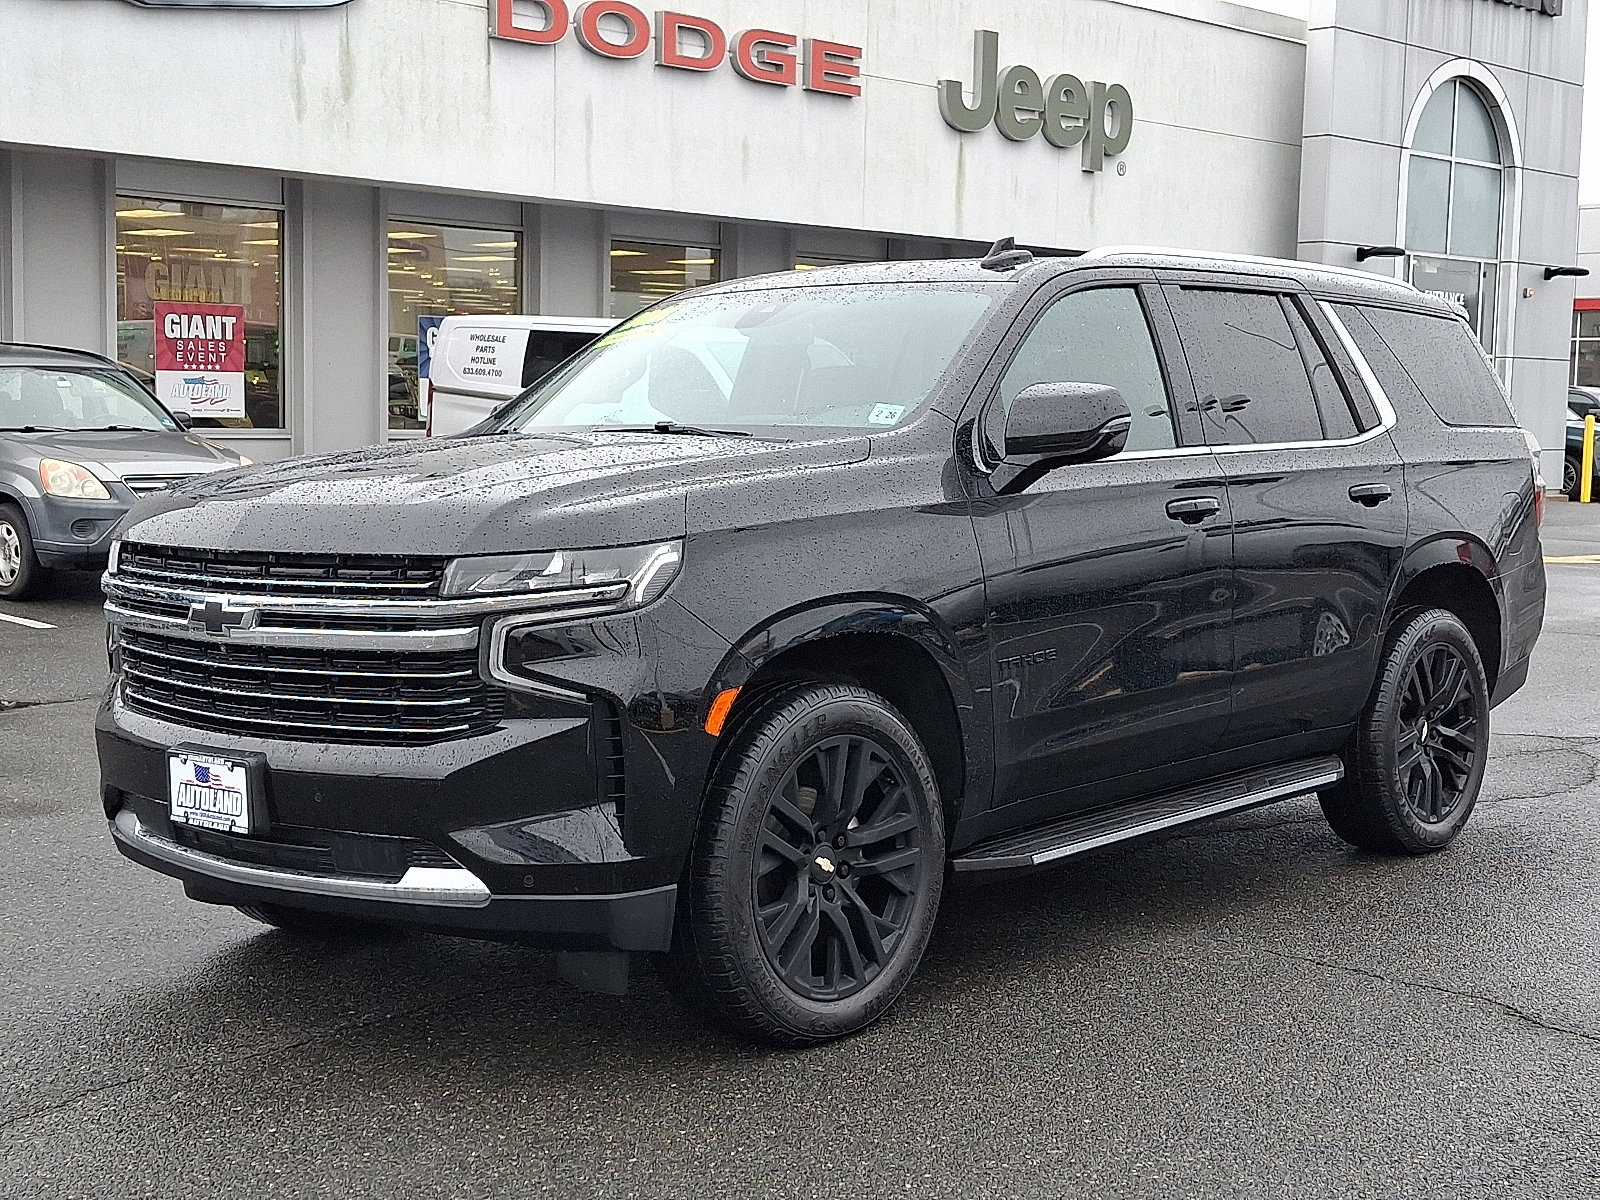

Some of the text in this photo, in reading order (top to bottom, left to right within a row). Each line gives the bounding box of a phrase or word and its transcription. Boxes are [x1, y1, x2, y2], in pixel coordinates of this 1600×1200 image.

[488, 0, 863, 98] DODGE
[937, 28, 1134, 174] Jeep
[145, 262, 258, 304] GIANT
[164, 313, 237, 340] GIANT
[176, 340, 226, 352] SALES
[470, 333, 507, 344] WHOLESALE
[176, 351, 227, 363] EVENT
[475, 345, 496, 354] PARTS
[470, 356, 497, 366] HOTLINE
[170, 383, 231, 399] AUTOLAND
[177, 782, 242, 817] AUTOLAND
[187, 818, 230, 832] AUTOLAND
